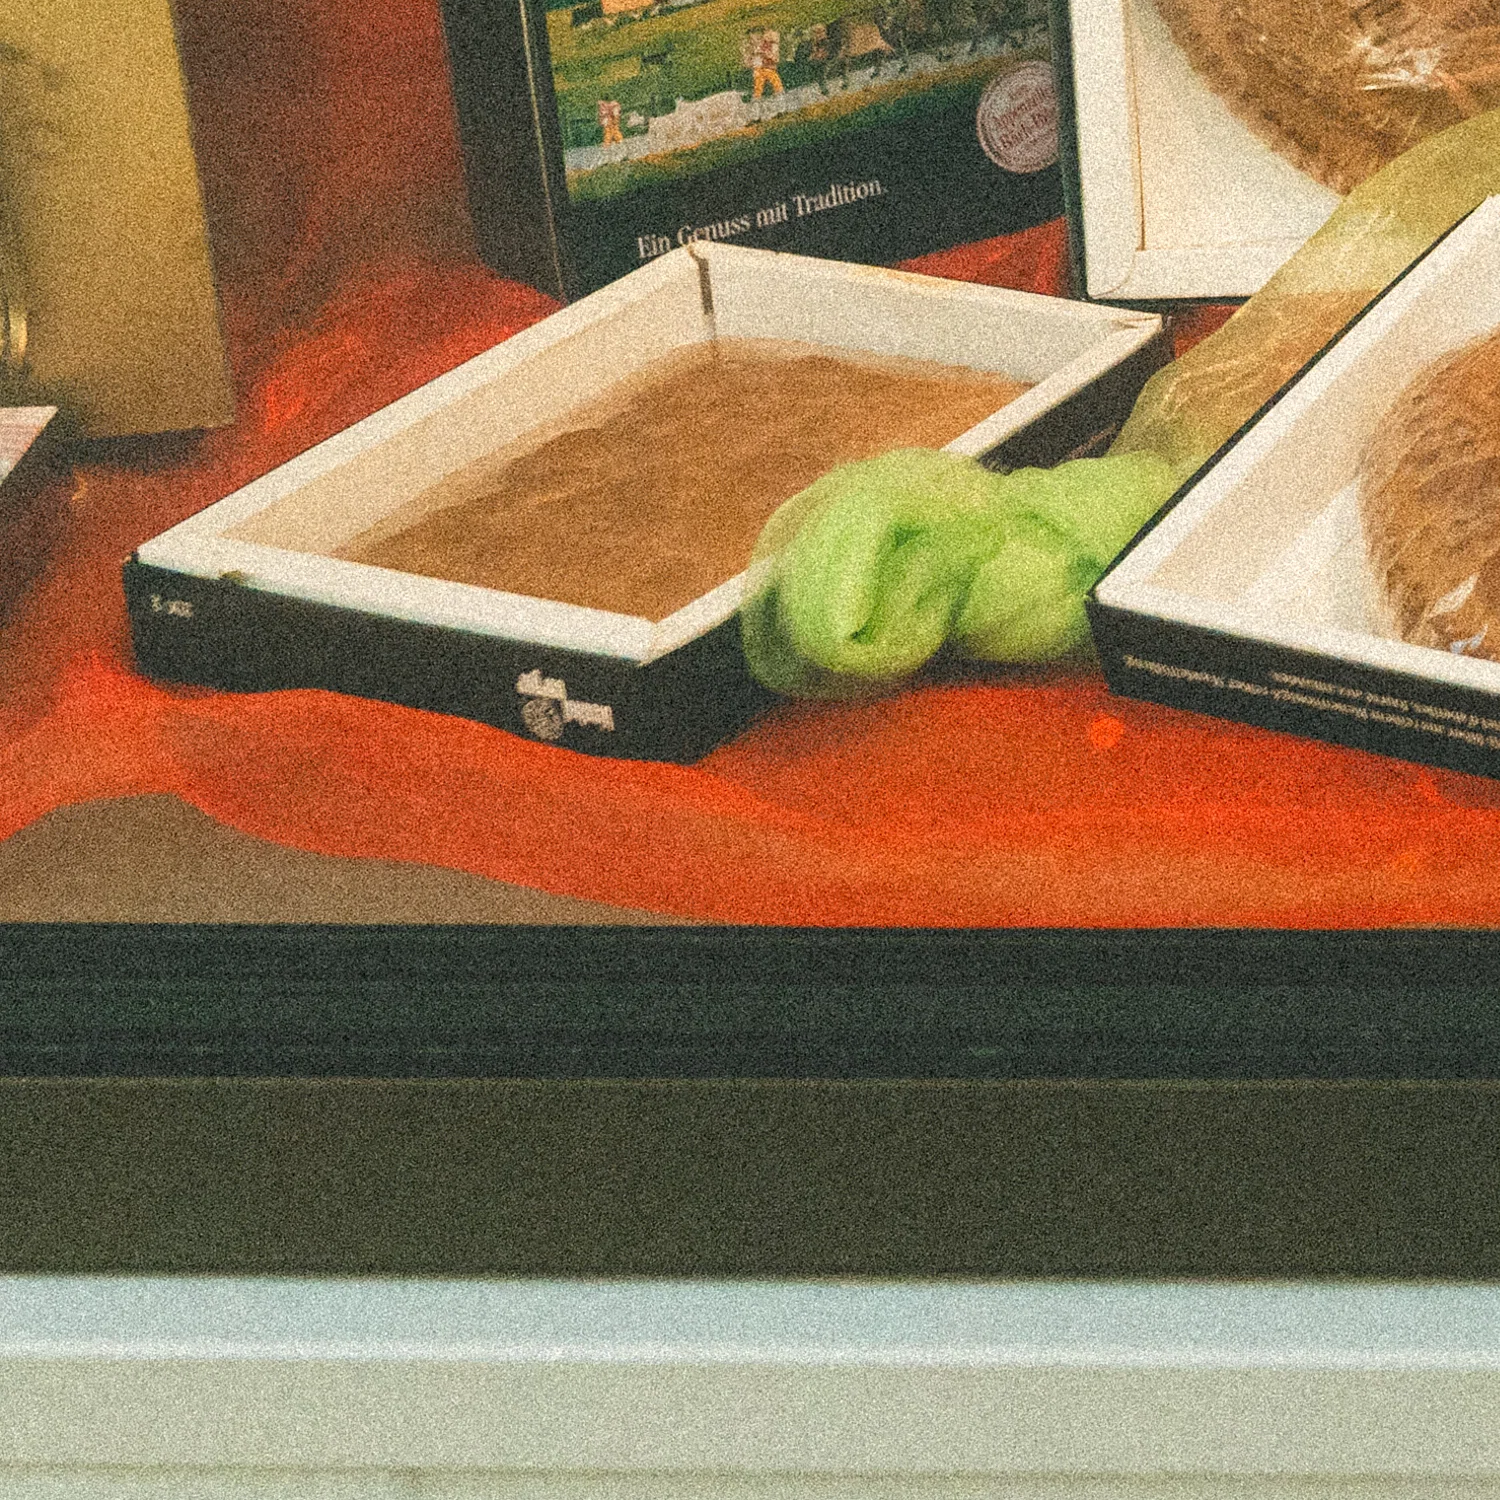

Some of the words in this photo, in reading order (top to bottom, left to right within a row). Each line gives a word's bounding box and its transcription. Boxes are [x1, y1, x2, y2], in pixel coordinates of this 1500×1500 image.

[636, 234, 671, 259] Ein
[677, 212, 752, 246] Genuss
[755, 201, 789, 229] mit
